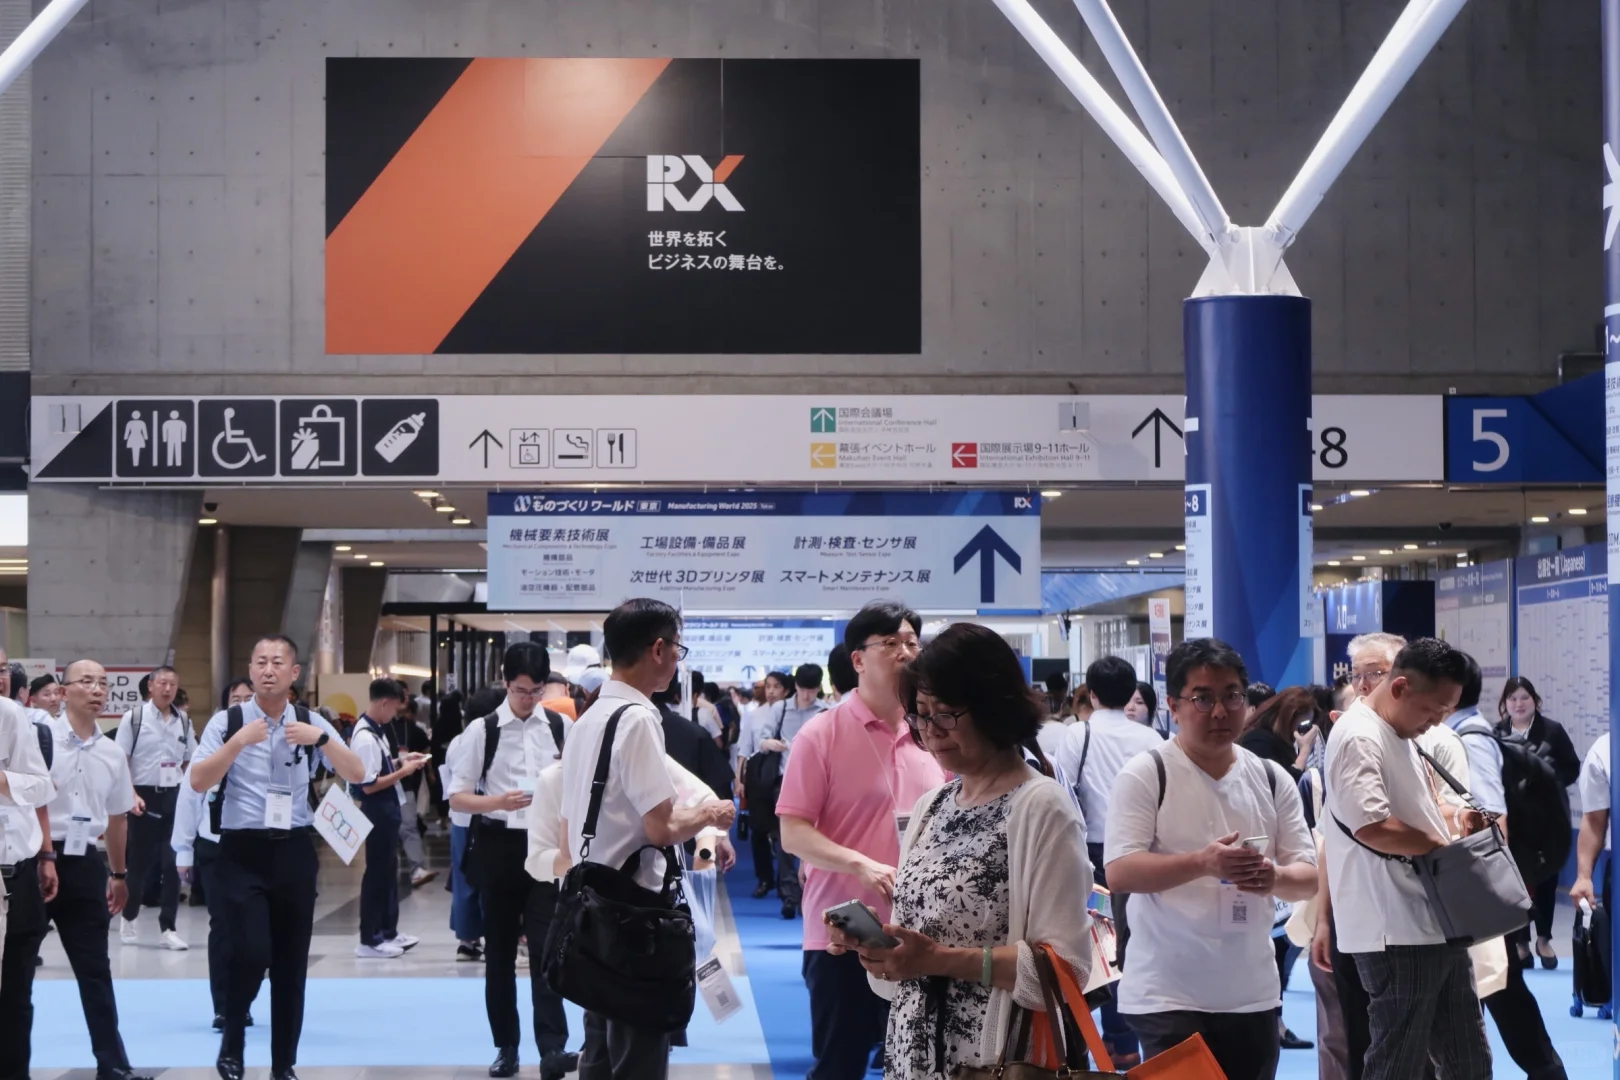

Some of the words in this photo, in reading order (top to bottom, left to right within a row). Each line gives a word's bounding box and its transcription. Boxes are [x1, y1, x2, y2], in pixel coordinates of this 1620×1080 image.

[647, 154, 746, 212] RX
[648, 230, 728, 247] 世界を拓く
[648, 253, 785, 271] ビジネスの舞台を。
[838, 407, 893, 418] 国際会議場
[1473, 409, 1510, 472] 5
[839, 443, 937, 454] 幕張イベントホール
[980, 442, 1090, 454] 国際展示場9-11ホール
[533, 499, 587, 512] ものづくり
[591, 499, 635, 512] ワールド
[639, 501, 657, 511] 東京
[668, 502, 717, 511] Manufacturing
[718, 502, 740, 510] World
[741, 502, 757, 510] 2025
[1014, 497, 1032, 508] RX
[509, 528, 610, 542] 機械要素技術展
[793, 536, 917, 550] 計測・検査・センサ展
[780, 570, 931, 583] スマートメンテナンス展
[1336, 604, 1347, 630] 入口
